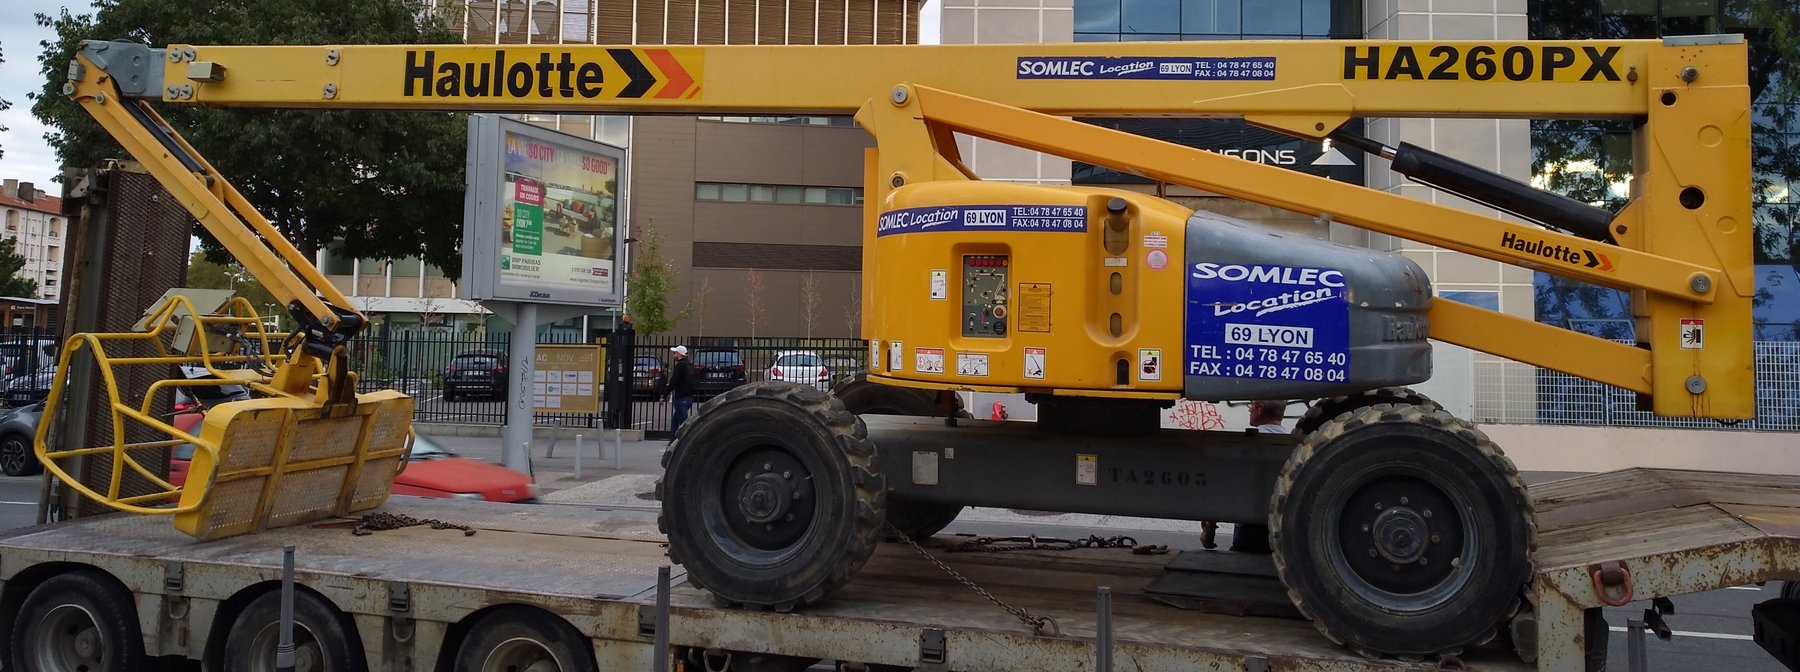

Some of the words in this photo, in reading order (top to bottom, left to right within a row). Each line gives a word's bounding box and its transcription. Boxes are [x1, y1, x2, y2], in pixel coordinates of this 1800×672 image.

[403, 50, 604, 98] Haulotte
[1019, 60, 1095, 76] SOMLEC
[1100, 61, 1155, 76] Location
[1160, 64, 1169, 73] 69
[1170, 64, 1191, 73] LYON
[1217, 61, 1227, 69] 04
[1229, 61, 1239, 69] 78
[1240, 61, 1251, 69] 47
[1252, 61, 1262, 69] 65
[1263, 61, 1274, 69] 40
[1343, 46, 1622, 81] HA260PX
[528, 143, 538, 159] SO
[539, 145, 555, 162] CITY
[581, 156, 590, 171] SO
[878, 211, 909, 231] SOMLEC
[909, 209, 958, 228] Location
[966, 212, 976, 224] 69
[979, 211, 1004, 225] LYON
[1040, 207, 1050, 216] 78
[1051, 207, 1061, 216] 47
[1063, 207, 1072, 217] 65
[1074, 208, 1084, 217] 40
[1040, 219, 1050, 228] 78
[1051, 219, 1061, 228] 47
[1063, 219, 1072, 228] 08
[1074, 219, 1084, 229] 04
[1501, 231, 1581, 264] Haulotte
[1192, 262, 1345, 287] SOMLEC
[1214, 287, 1334, 317] Location
[1231, 326, 1251, 342] 69
[1258, 328, 1309, 345] LYON
[1191, 345, 1222, 360] TEL
[1235, 347, 1254, 361] 04
[1258, 348, 1277, 362] 78
[1281, 350, 1300, 363] 47
[1304, 351, 1323, 365] 65
[1327, 352, 1346, 366] 40
[1190, 361, 1221, 376] FAX
[1235, 364, 1254, 377] 04
[1258, 365, 1277, 379] 78
[1281, 366, 1300, 380] 47
[1304, 367, 1323, 381] 08
[1327, 368, 1346, 382] 04
[1108, 467, 1208, 488] TA2605
